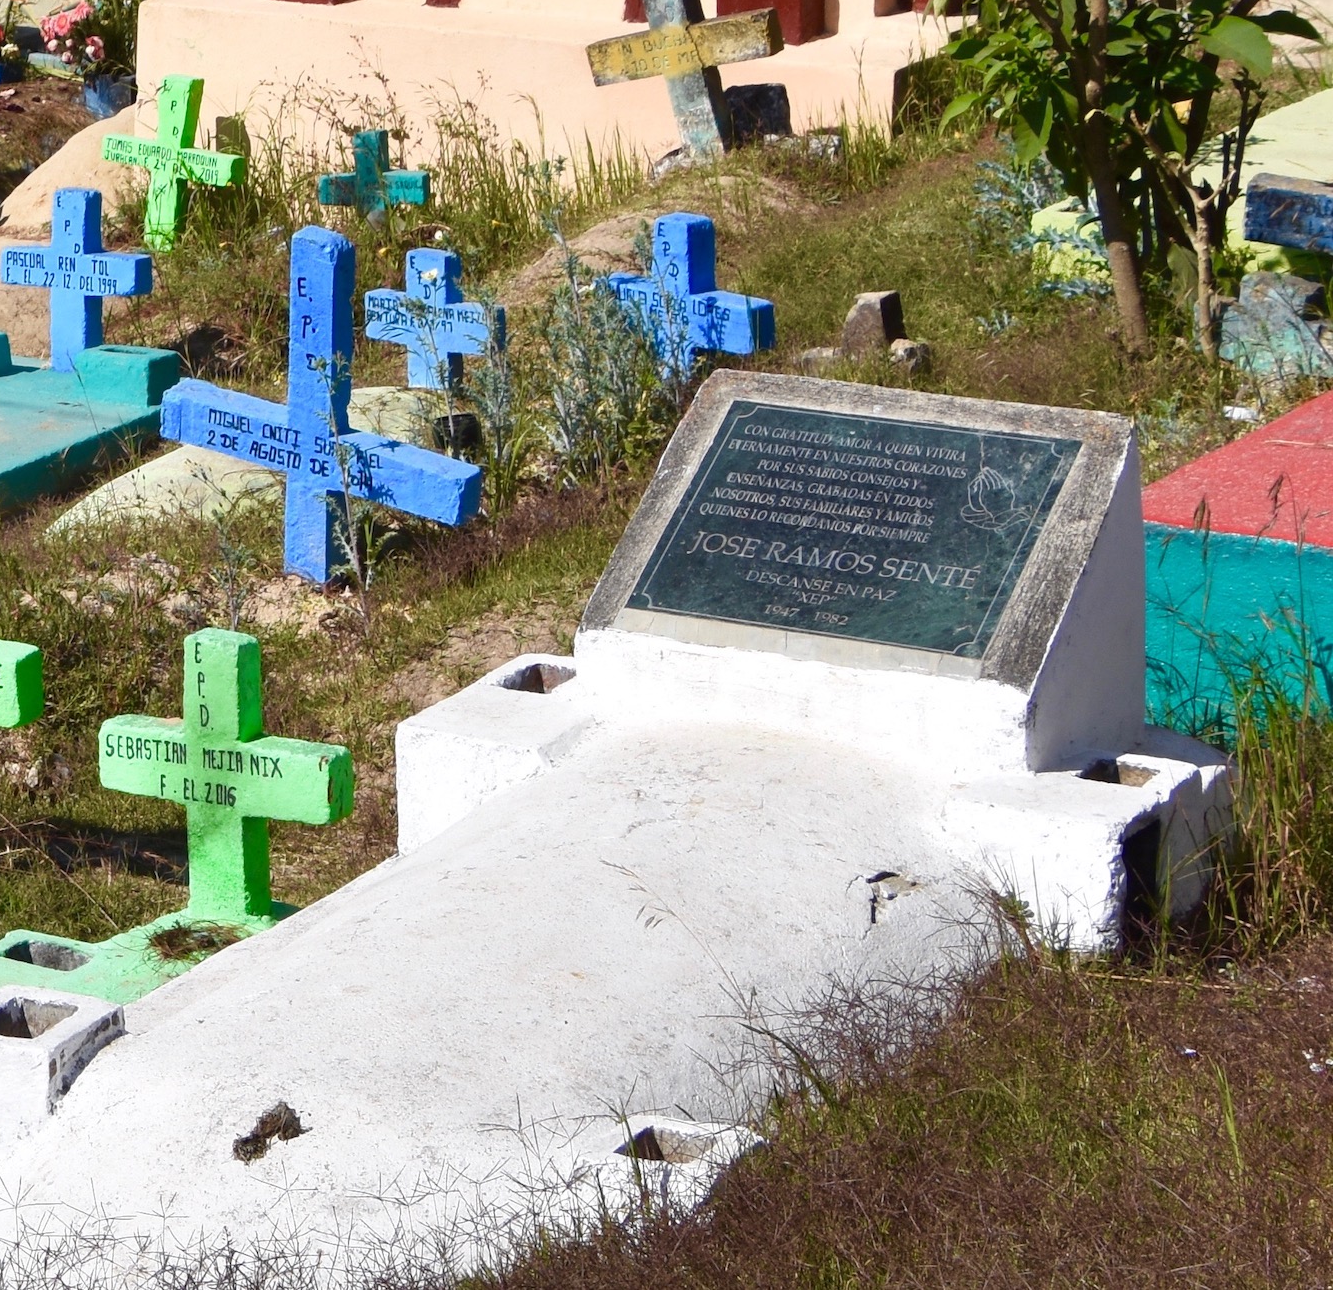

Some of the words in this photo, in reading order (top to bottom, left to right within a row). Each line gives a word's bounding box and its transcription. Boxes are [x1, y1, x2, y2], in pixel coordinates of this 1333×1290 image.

[106, 137, 132, 153] TOMAS
[138, 144, 172, 160] EDUARDO
[6, 251, 45, 269] PASCUAL
[59, 257, 76, 272] REN
[92, 260, 109, 276] TOL
[80, 276, 94, 291] DEL
[208, 408, 253, 434] MIGUEL
[207, 430, 216, 446] 2
[221, 434, 238, 452] DE
[250, 441, 301, 469] AGOSTO
[310, 459, 329, 477] DE
[729, 439, 812, 459] ETERNAMENTE
[814, 449, 830, 460] EN
[832, 451, 892, 470] NUESTROS
[894, 460, 967, 478] CORAZONES
[745, 424, 769, 437] CON
[834, 436, 872, 450] AMOR
[885, 441, 922, 457] QUIEN
[925, 446, 966, 462] VIVIRA
[726, 472, 804, 493] ENSEÑANZAS,
[807, 483, 872, 501] GRABADAS
[874, 490, 891, 503] EN
[893, 494, 935, 509] TODOS
[757, 460, 781, 472] POR
[783, 462, 805, 475] SUS
[805, 466, 849, 480] SABIOS
[849, 471, 907, 488] CONSEJOS
[909, 479, 921, 490] Y
[699, 502, 749, 518] QUIENES
[751, 508, 767, 521] LO
[769, 512, 849, 532] RECORDAMOS
[852, 522, 879, 535] POR
[880, 526, 931, 544] SIEMPRE
[711, 487, 776, 506] NOSOTROS,
[779, 496, 801, 508] SUS
[803, 498, 872, 518] FAMILIARES
[883, 509, 934, 526] AMIGOS
[687, 531, 761, 558] JOSE
[763, 541, 875, 574] RAMOS
[879, 558, 981, 589] SENTÉ
[745, 570, 833, 592] DESCANSE
[833, 582, 857, 596] EN
[861, 586, 897, 602] PAZ
[764, 604, 799, 617] 1947
[813, 612, 849, 626] 1982
[106, 734, 187, 764] SEBASTIAN
[203, 748, 243, 773] MEJIA
[250, 754, 283, 778] NIX
[184, 778, 198, 802] EL
[205, 783, 237, 807] 2016
